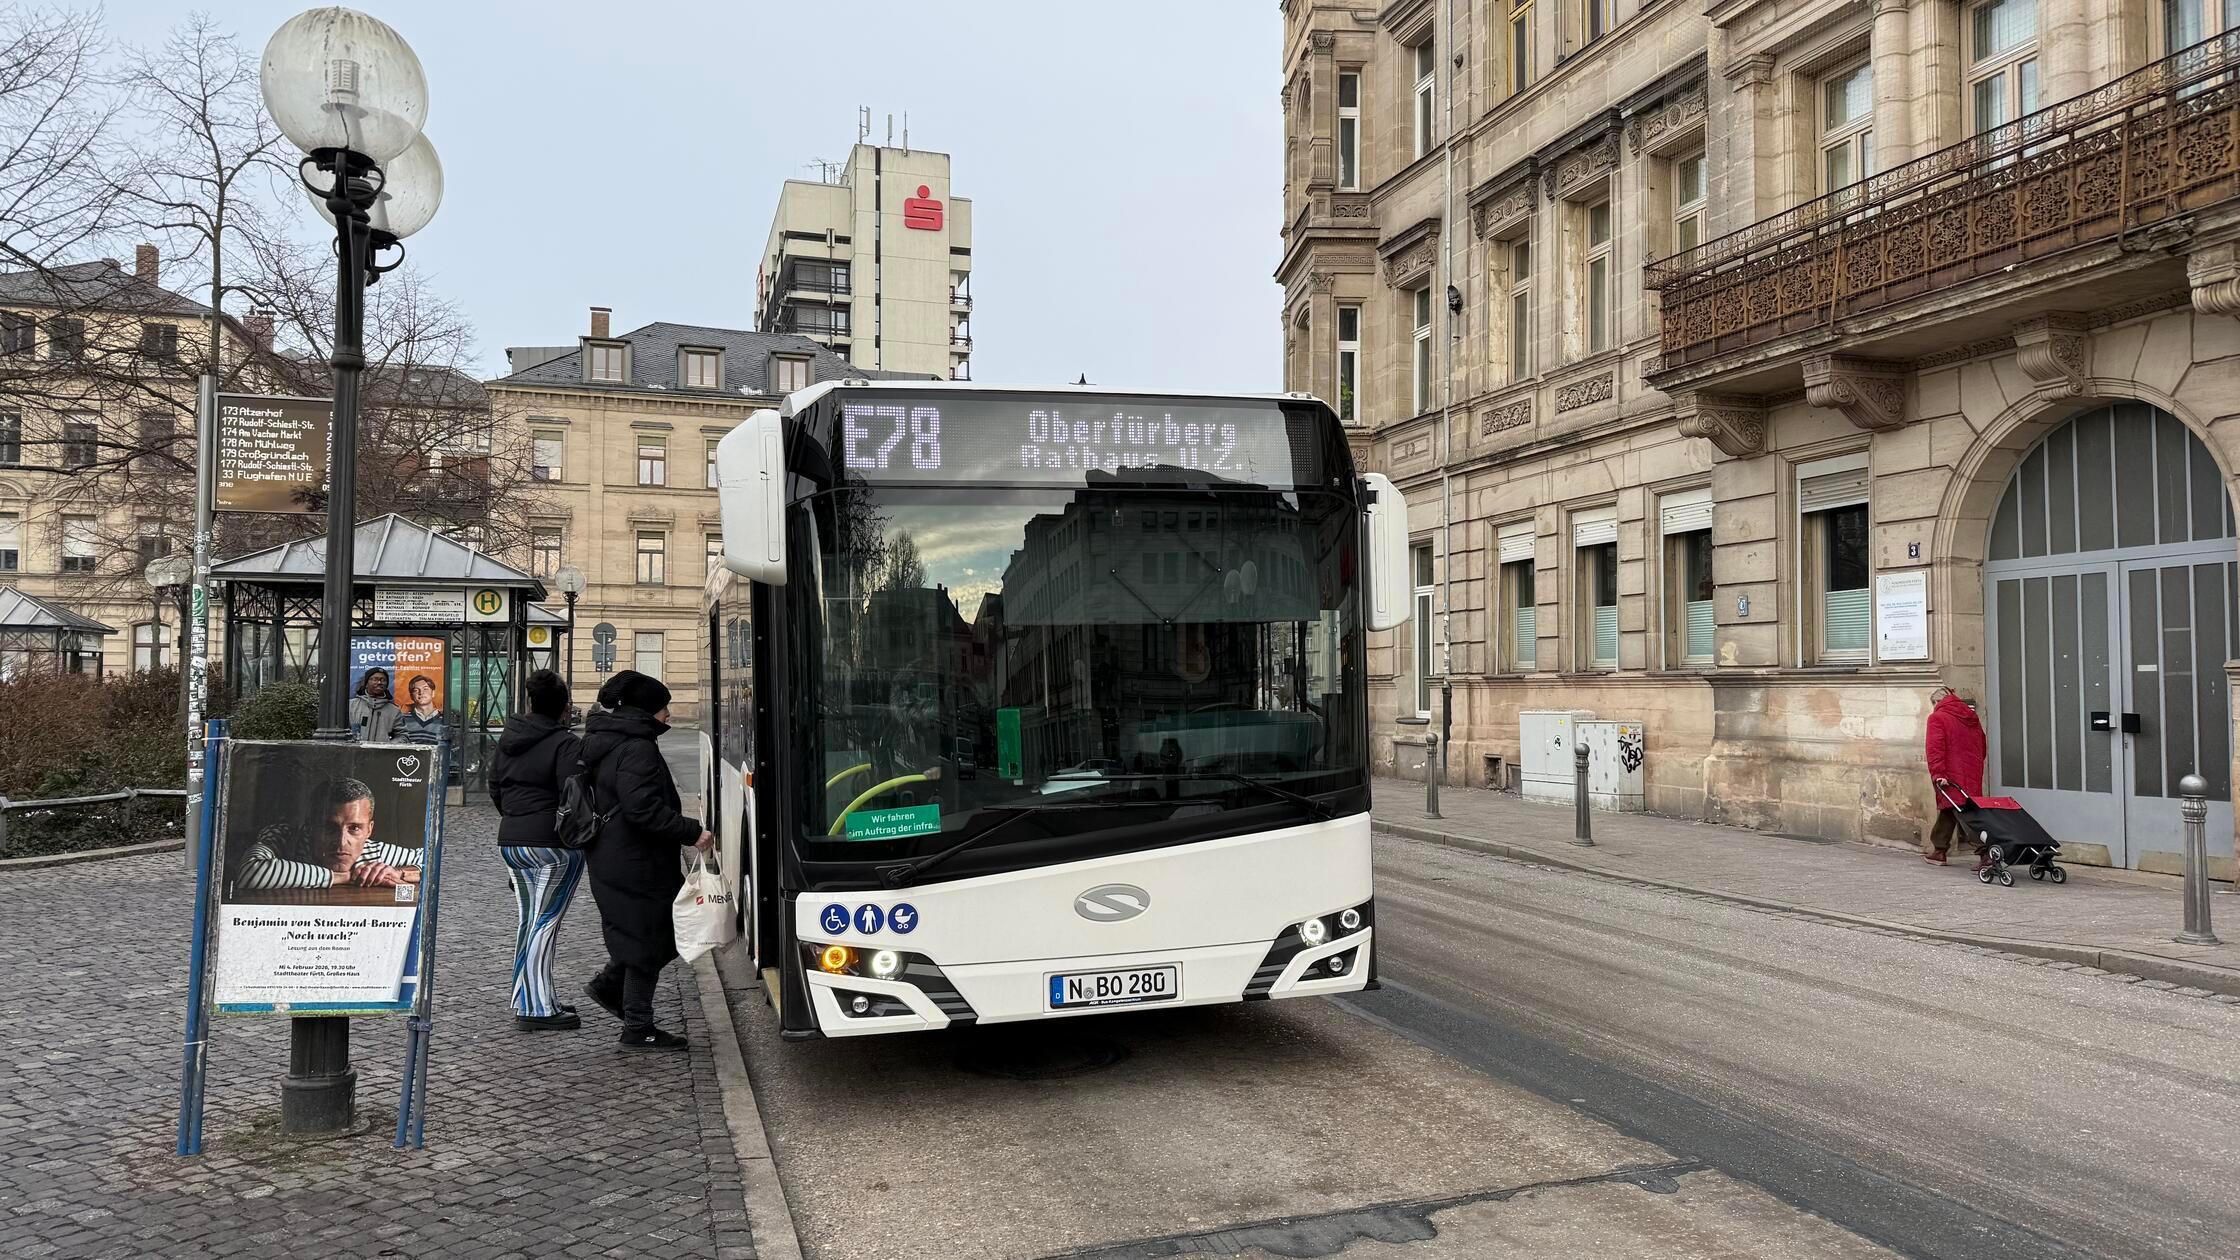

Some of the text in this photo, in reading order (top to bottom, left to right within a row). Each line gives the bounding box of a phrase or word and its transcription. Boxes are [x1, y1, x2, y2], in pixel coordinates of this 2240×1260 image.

[222, 406, 283, 417] 173 Atzenhof
[222, 417, 238, 426] 177
[239, 417, 315, 430] Rudolf-Schiestl-Str.
[1029, 409, 1237, 448] Oberfürberg
[221, 427, 237, 436] 174
[239, 429, 250, 437] Am
[252, 429, 279, 438] Vacher
[280, 430, 302, 439] Markt
[843, 404, 941, 470] E78
[221, 438, 237, 447] 178
[239, 439, 253, 448] Am
[255, 440, 295, 451] Mühlweg
[221, 449, 237, 458] 179
[238, 450, 309, 460] Großgründlach
[1020, 444, 1159, 471] Rathaus
[220, 460, 237, 468] 177
[238, 460, 314, 472] Rudolf-Schiestl-Str.
[222, 470, 233, 479] 33
[237, 470, 286, 481] Flughafen
[1910, 546, 1916, 556] 3
[480, 594, 496, 610] H
[351, 639, 442, 652] Entscheidung
[359, 652, 431, 663] getroffen?
[871, 812, 916, 824] Wir fahren
[864, 826, 897, 836] Auftrag
[898, 824, 912, 833] der
[233, 917, 408, 929] Benjamin von Stuckrad-Barre:
[1069, 978, 1083, 1000] N
[1096, 975, 1123, 998] BO
[1128, 972, 1165, 995] 280
